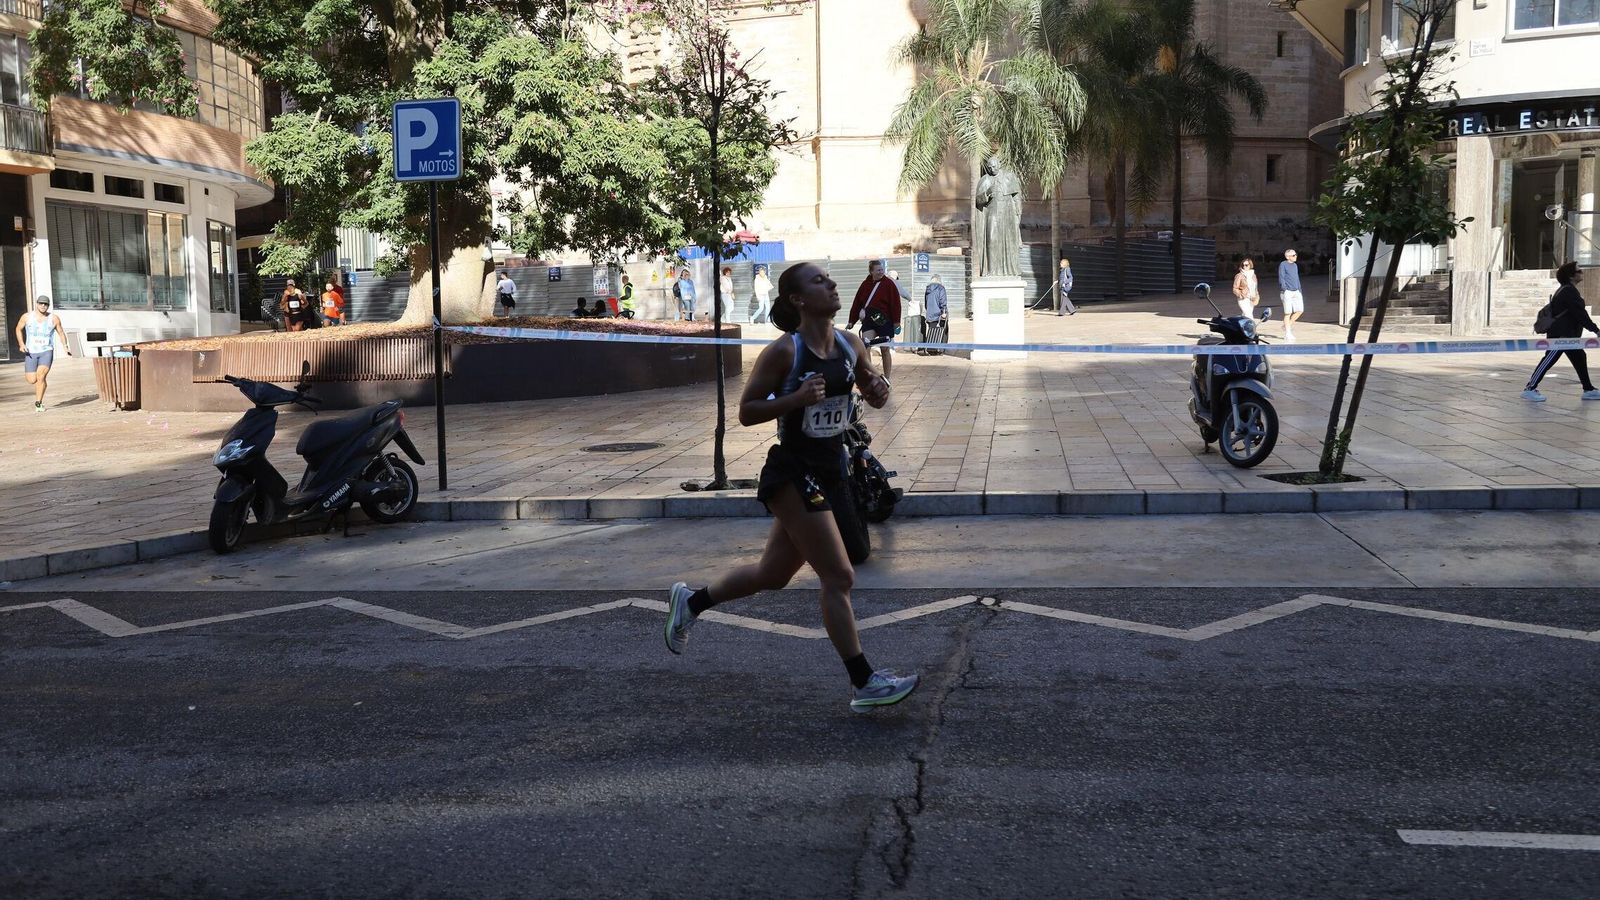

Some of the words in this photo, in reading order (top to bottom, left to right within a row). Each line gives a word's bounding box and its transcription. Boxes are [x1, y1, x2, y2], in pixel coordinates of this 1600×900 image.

[1448, 114, 1506, 136] REAL
[1519, 107, 1600, 130] ESTAT
[397, 108, 439, 172] P
[418, 159, 456, 173] MOTOS
[812, 410, 843, 425] 110
[329, 483, 350, 502] YAMAHA
